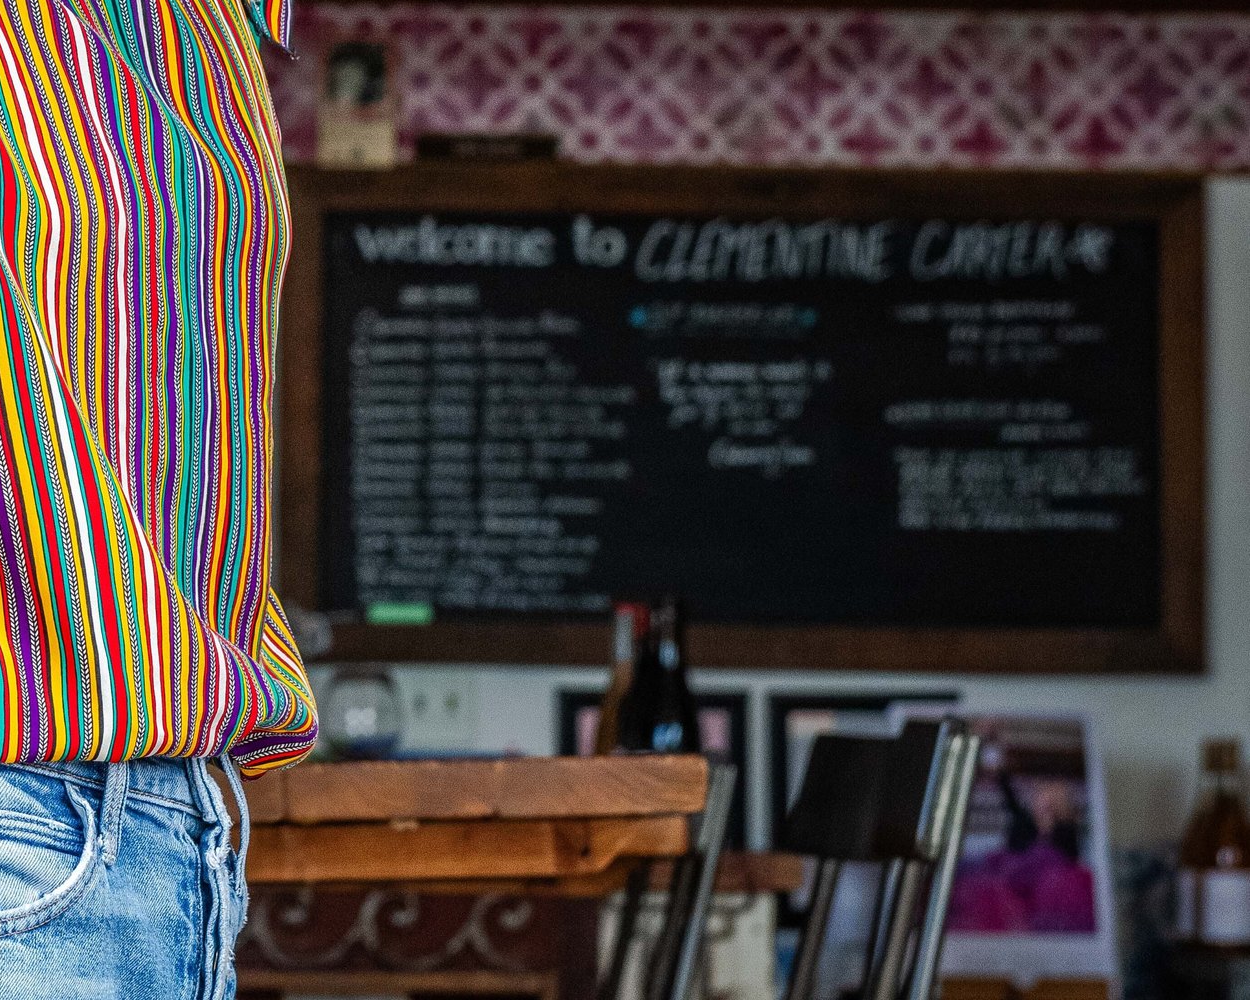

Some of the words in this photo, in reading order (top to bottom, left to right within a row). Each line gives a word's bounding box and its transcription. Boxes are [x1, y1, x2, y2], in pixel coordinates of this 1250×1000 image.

[354, 214, 554, 268] welcome
[573, 213, 626, 268] to
[634, 217, 892, 283] CLEMENTINE
